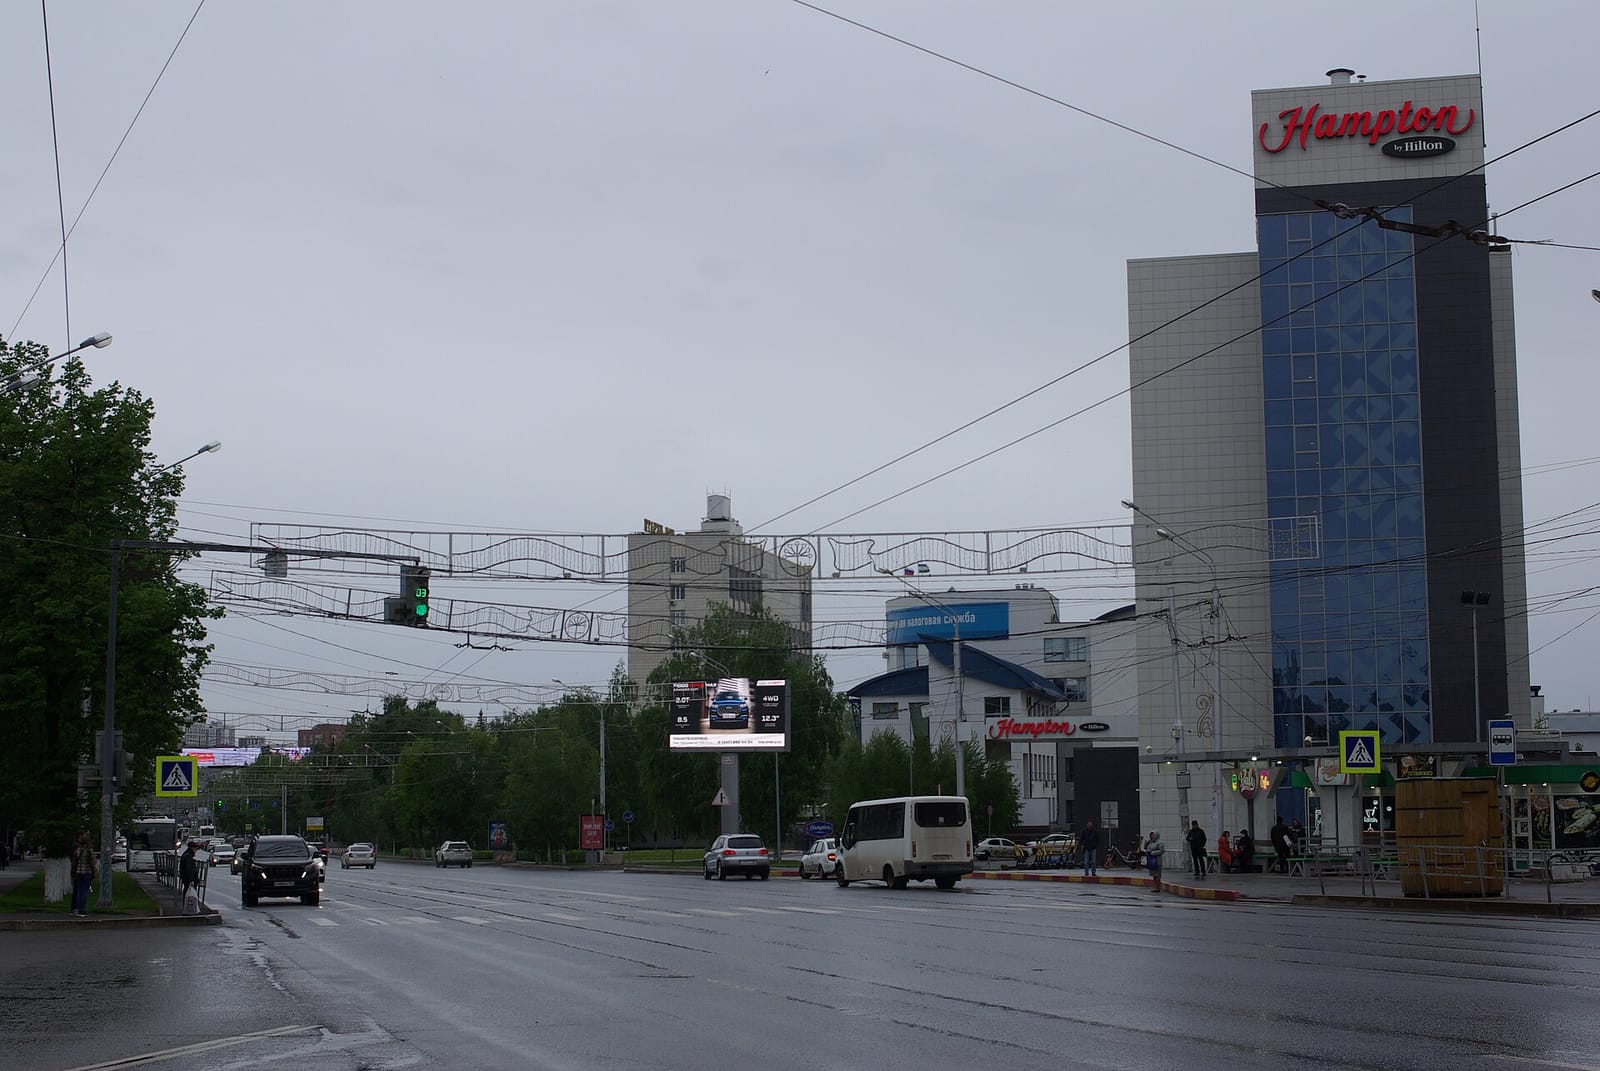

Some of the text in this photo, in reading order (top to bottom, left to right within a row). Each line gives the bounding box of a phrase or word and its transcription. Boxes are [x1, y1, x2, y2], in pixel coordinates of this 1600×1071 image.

[1259, 101, 1475, 154] Hampton
[1394, 140, 1443, 152] by Hilton
[415, 588, 426, 598] 03
[908, 616, 941, 627] налоговая
[943, 611, 976, 625] служба
[989, 718, 1077, 740] Hampton
